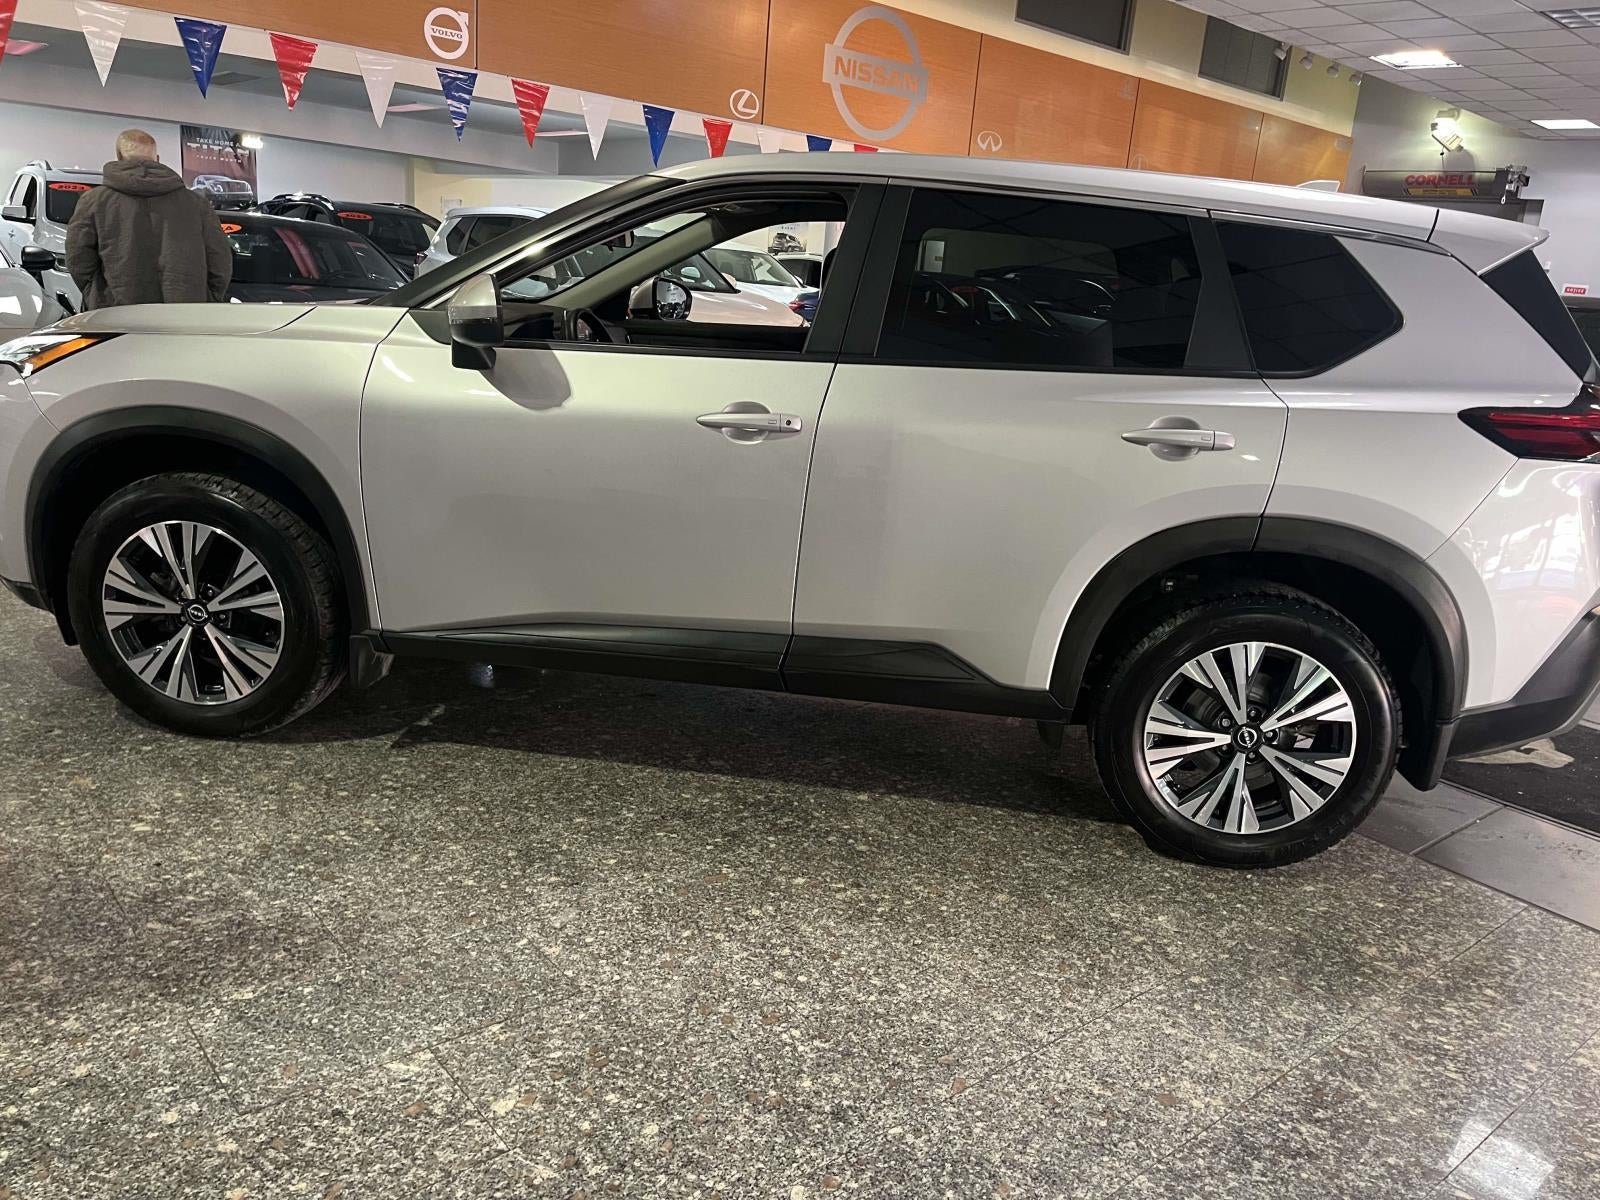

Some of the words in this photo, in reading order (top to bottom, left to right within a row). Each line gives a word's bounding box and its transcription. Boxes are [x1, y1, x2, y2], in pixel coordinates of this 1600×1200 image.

[431, 28, 463, 39] VOLVO
[835, 55, 919, 95] NISSAN
[1405, 174, 1474, 186] CORNELL
